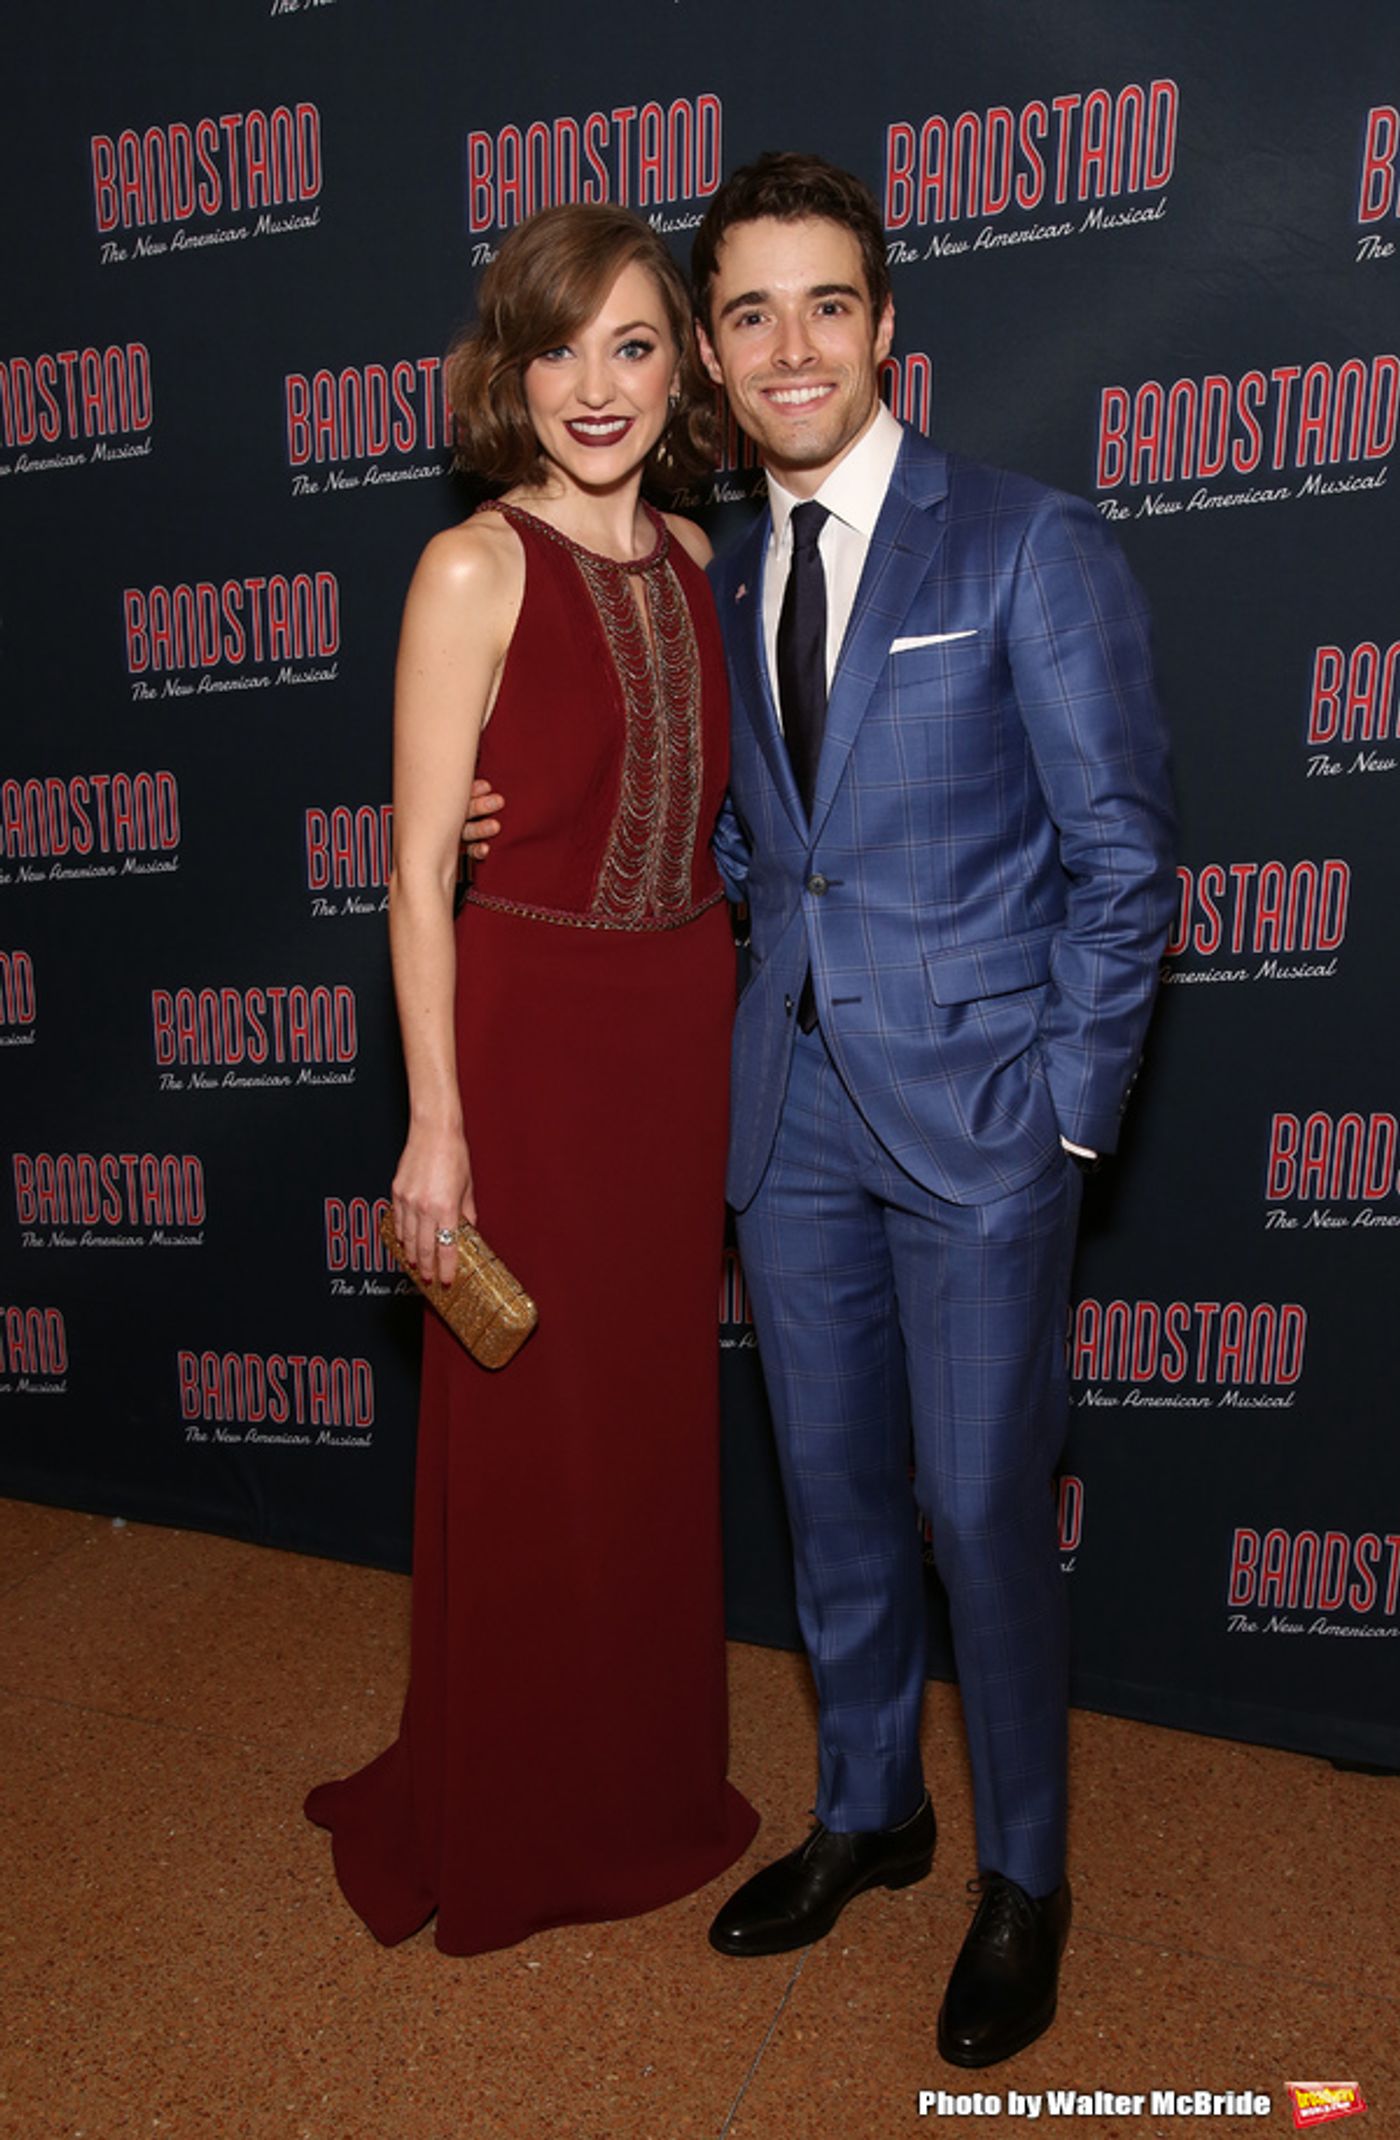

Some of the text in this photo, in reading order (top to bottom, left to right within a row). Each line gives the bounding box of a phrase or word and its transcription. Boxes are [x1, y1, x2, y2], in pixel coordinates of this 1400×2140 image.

[91, 102, 322, 233] BANDSTAND
[468, 93, 722, 233] BANDSTAND
[885, 78, 1178, 230] BANDSTAND
[101, 206, 321, 265] The New American Musical
[885, 197, 1168, 266] The New American Musical
[1356, 235, 1396, 263] The
[1096, 354, 1400, 489] BANDSTAND
[15, 454, 87, 474] American
[91, 437, 152, 463] Musical
[291, 464, 443, 496] The New American
[1097, 466, 1388, 521] The New American Musical
[124, 571, 340, 673] BANDSTAND
[132, 662, 339, 701] The New American Musical
[1306, 750, 1398, 778] The New
[0, 770, 180, 859] ANDSTAND
[15, 865, 46, 884] New
[49, 863, 118, 881] American
[121, 854, 180, 876] Musical
[311, 898, 338, 917] The
[341, 896, 375, 915] New
[1253, 957, 1339, 981] Musical
[151, 985, 358, 1065] BANDSTAND
[160, 1067, 356, 1091] The New American Musical
[1266, 1111, 1400, 1200] BAND
[12, 1153, 206, 1226] BANDSTAND
[1265, 1209, 1298, 1229] The
[1302, 1208, 1350, 1229] New
[21, 1229, 204, 1248] The New American Musical
[331, 1278, 356, 1296] The
[359, 1279, 392, 1296] New
[1064, 1298, 1306, 1385] ANDSTAND
[178, 1351, 375, 1427] BANDSTAND
[1078, 1388, 1296, 1409] New American Musical
[185, 1425, 372, 1447] The New American Musical
[1227, 1614, 1258, 1633] The
[1262, 1615, 1304, 1634] New
